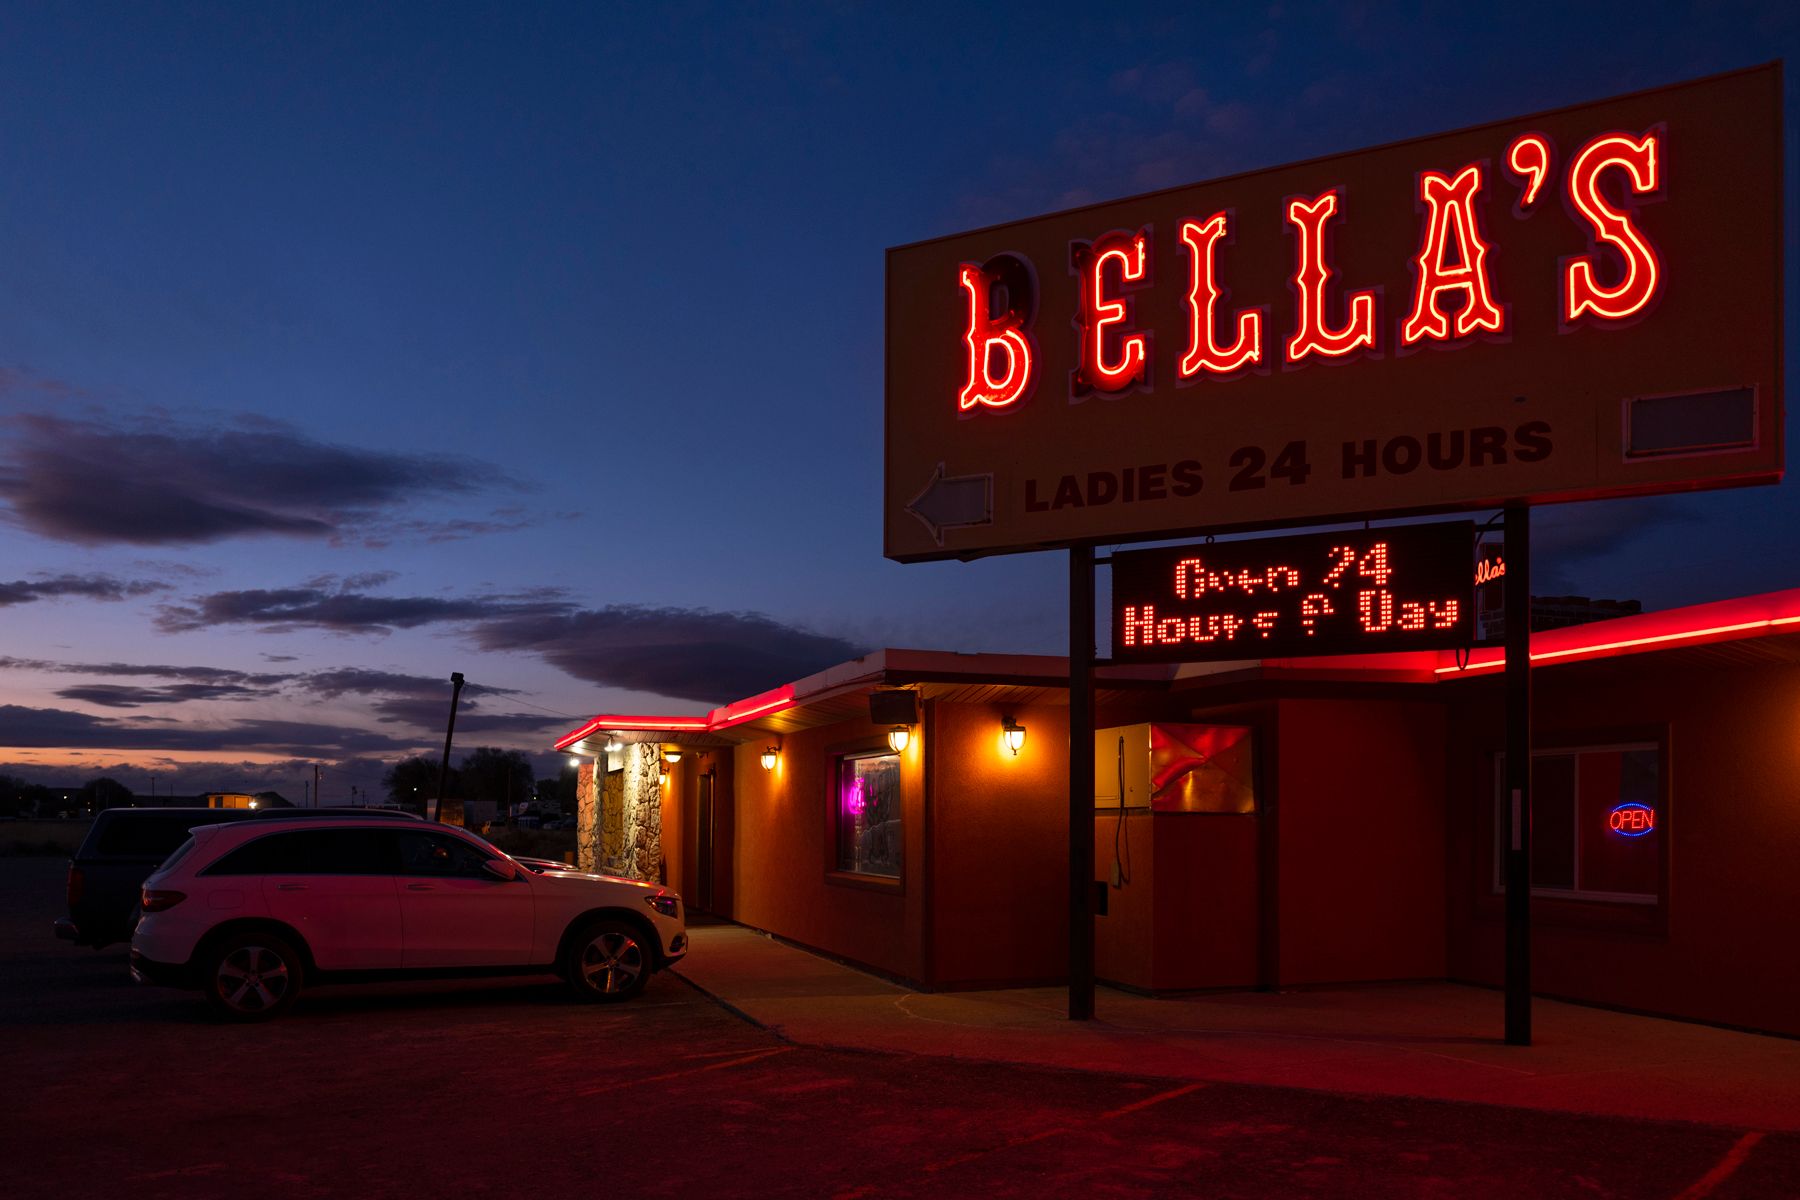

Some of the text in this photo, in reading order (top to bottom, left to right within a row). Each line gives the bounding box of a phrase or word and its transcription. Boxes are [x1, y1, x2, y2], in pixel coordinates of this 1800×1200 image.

[957, 132, 1661, 411] BELLA'S
[1024, 420, 1554, 513] LADIES 24 HOURS
[1323, 542, 1392, 589] 24
[1359, 588, 1458, 632] Day
[1609, 808, 1656, 831] OPEN
